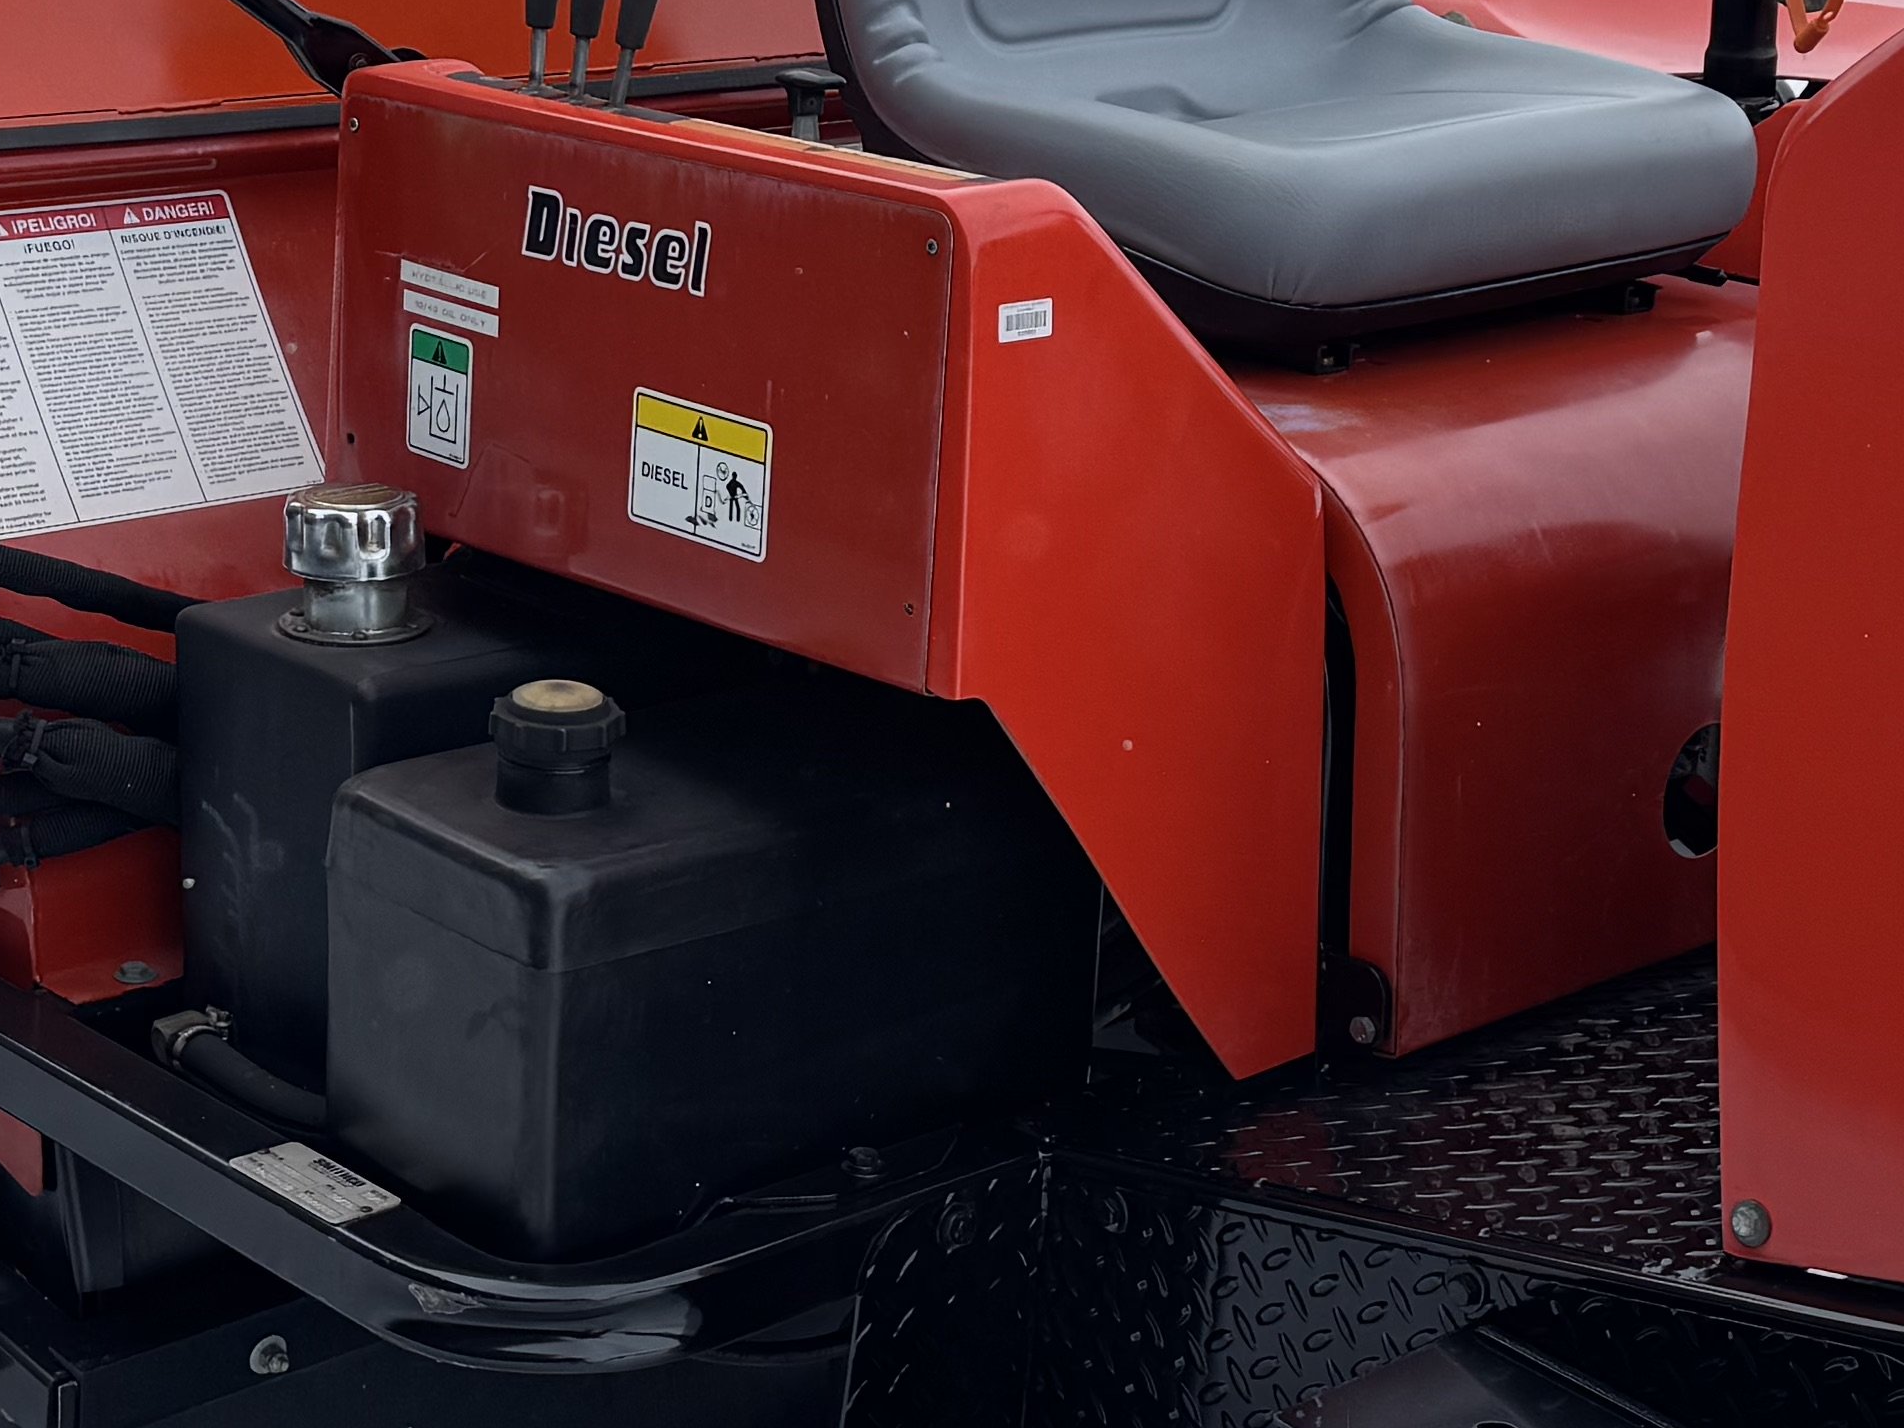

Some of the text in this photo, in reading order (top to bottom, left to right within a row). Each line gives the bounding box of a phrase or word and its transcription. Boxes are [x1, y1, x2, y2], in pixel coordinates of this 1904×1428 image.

[142, 201, 215, 222] DANGER!
[521, 184, 712, 298] Diesel
[641, 461, 688, 490] DIESEL
[704, 495, 712, 508] D
